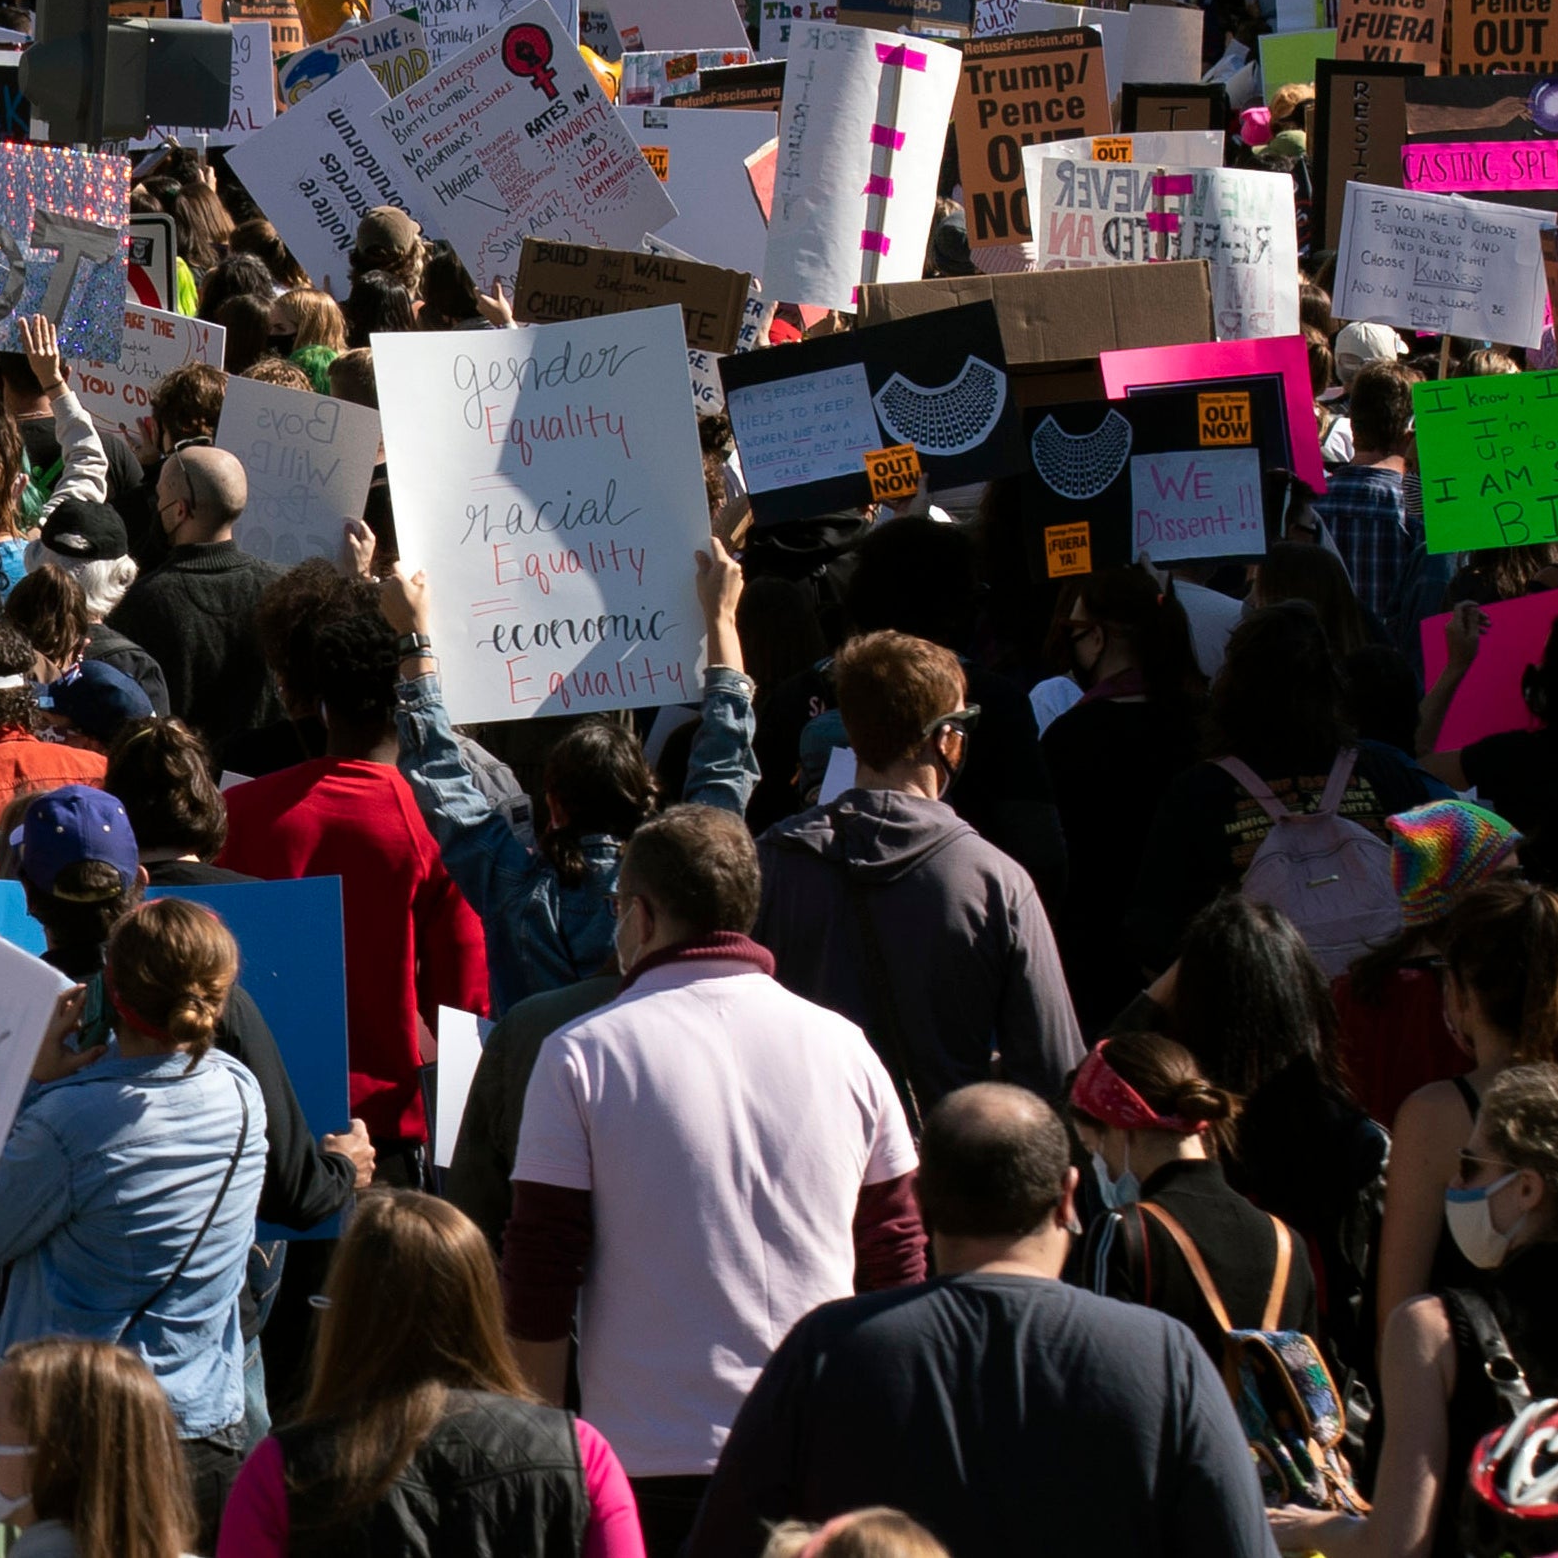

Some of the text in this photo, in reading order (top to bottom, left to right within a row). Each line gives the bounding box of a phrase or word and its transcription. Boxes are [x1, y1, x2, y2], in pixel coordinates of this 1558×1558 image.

[1341, 14, 1435, 45] ¡FUERA
[454, 340, 646, 430] gender
[484, 404, 626, 467] Equality
[1202, 421, 1249, 440] NOW
[1204, 404, 1246, 423] OUT
[1149, 461, 1214, 501] WE
[460, 480, 643, 546] racial
[493, 544, 646, 592] Equality
[477, 606, 679, 654] economic
[507, 656, 687, 708] Equality
